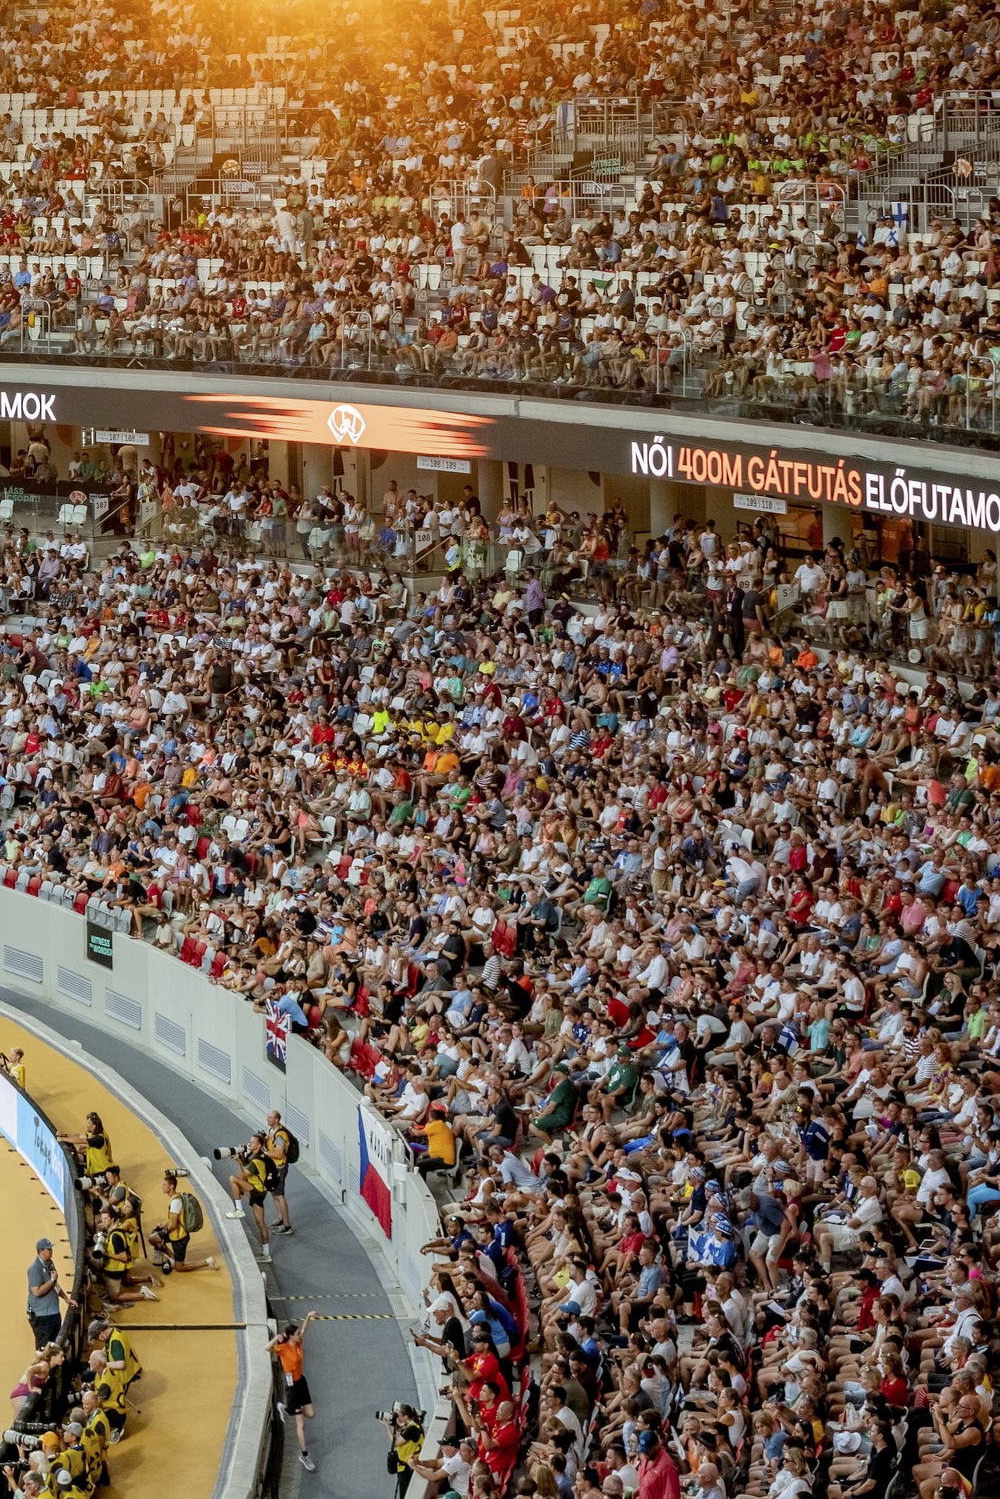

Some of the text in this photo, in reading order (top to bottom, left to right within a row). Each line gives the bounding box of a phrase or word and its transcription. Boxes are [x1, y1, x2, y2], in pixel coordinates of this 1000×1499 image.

[631, 435, 673, 477] NŐI
[677, 447, 743, 488] 400M
[748, 450, 862, 506] GÁTFUTÁS
[96, 501, 107, 509] 107
[417, 534, 431, 542] 108
